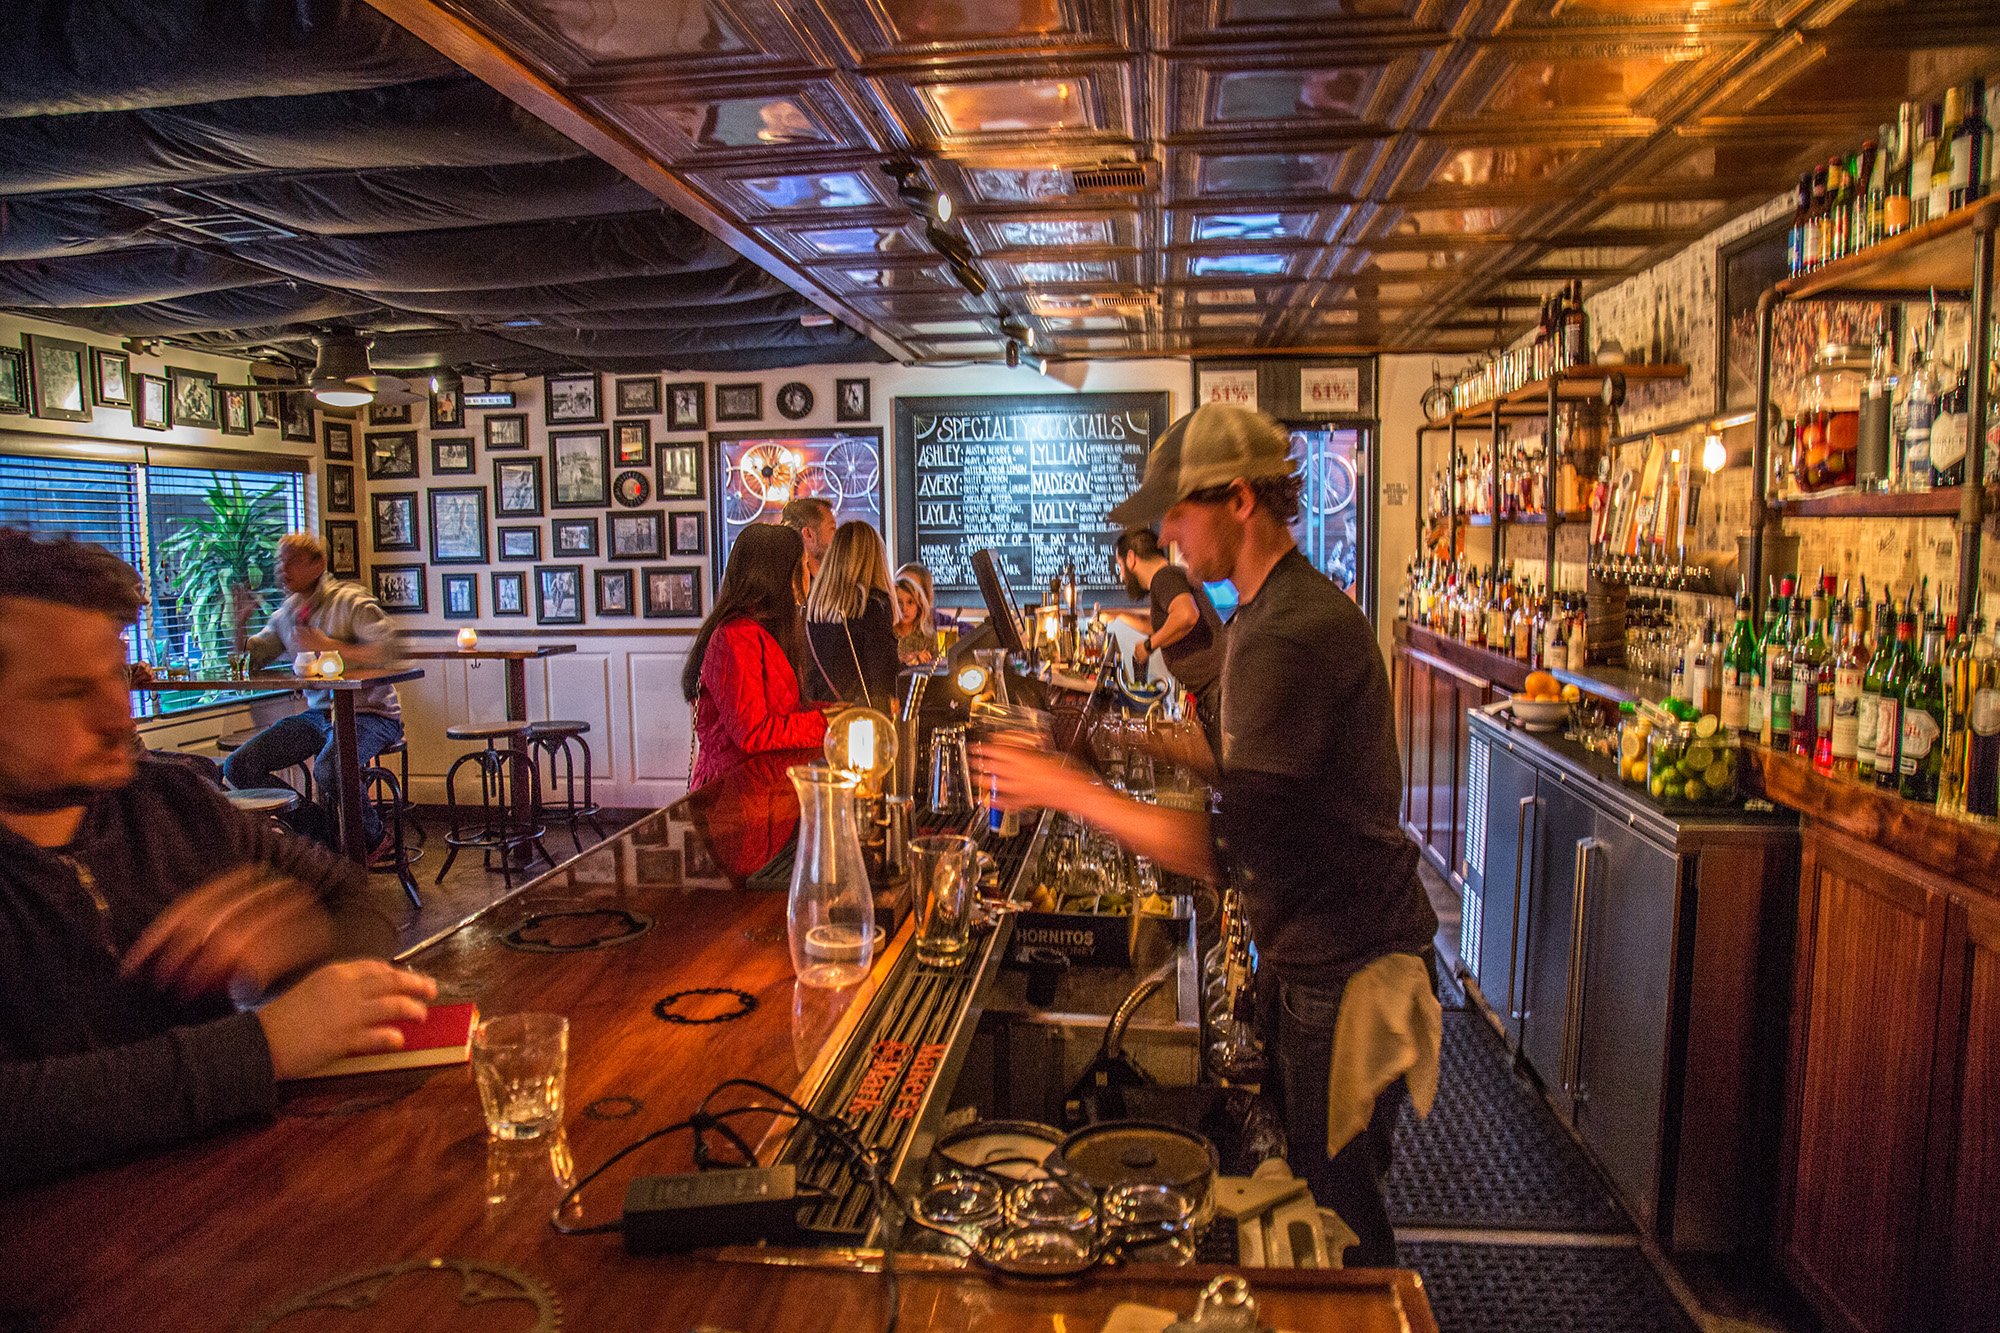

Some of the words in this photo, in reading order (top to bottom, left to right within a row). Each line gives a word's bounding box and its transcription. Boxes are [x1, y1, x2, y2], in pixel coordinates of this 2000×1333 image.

[1211, 385, 1249, 402] 51%
[1312, 383, 1350, 401] 51%
[937, 416, 1031, 442] SPECIALTY
[1036, 414, 1126, 440] COCKTAILS
[967, 533, 1007, 548] WHISKEY
[1011, 534, 1023, 547] OF
[1029, 533, 1044, 547] THE
[1050, 533, 1066, 547] DAY
[920, 545, 951, 556] MONDAY
[1035, 545, 1060, 556] FRIDAY
[1069, 545, 1096, 556] HEAVEN
[1100, 545, 1114, 556] HILL
[921, 555, 955, 566] TUESDAY
[932, 575, 957, 586] URSDAY
[1015, 928, 1095, 947] HORNITOS
